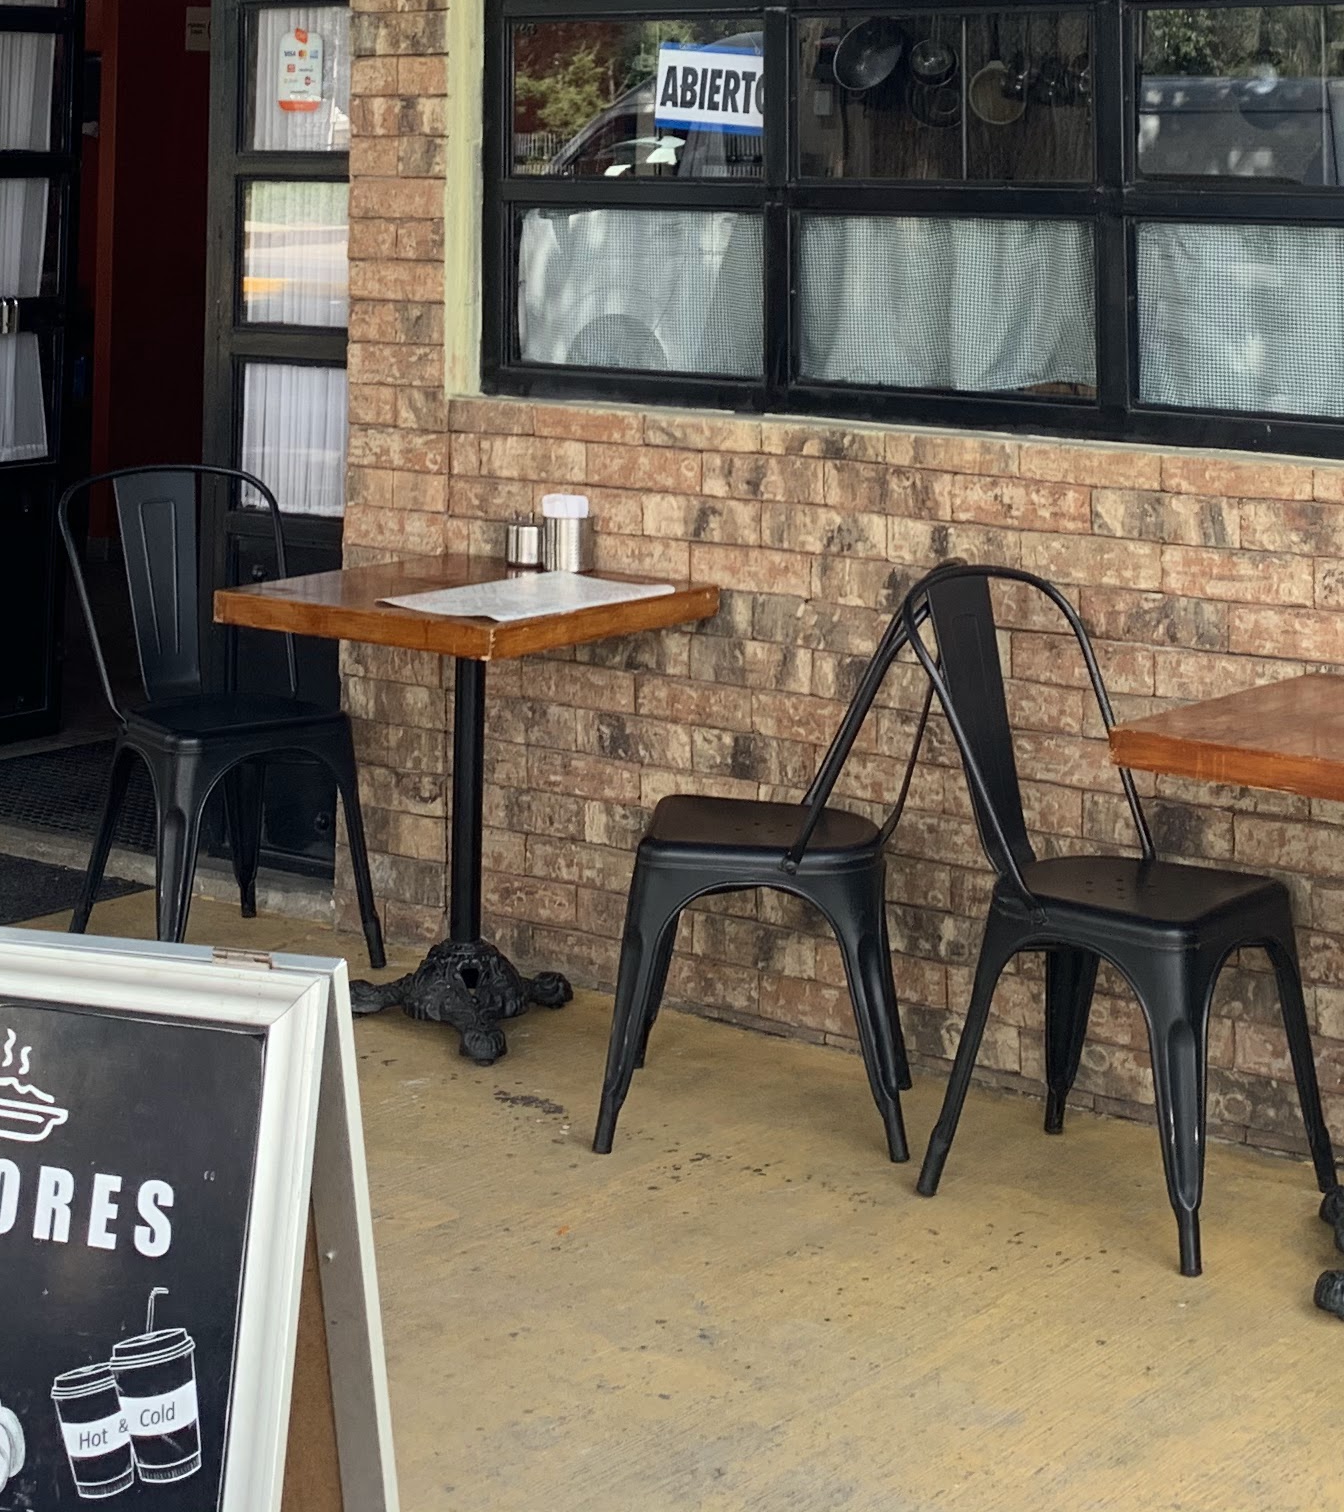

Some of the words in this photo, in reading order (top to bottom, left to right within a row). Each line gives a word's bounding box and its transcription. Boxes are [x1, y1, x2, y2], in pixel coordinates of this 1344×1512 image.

[78, 1427, 109, 1451] Hot
[117, 1418, 129, 1435] &
[139, 1402, 176, 1429] Cold
